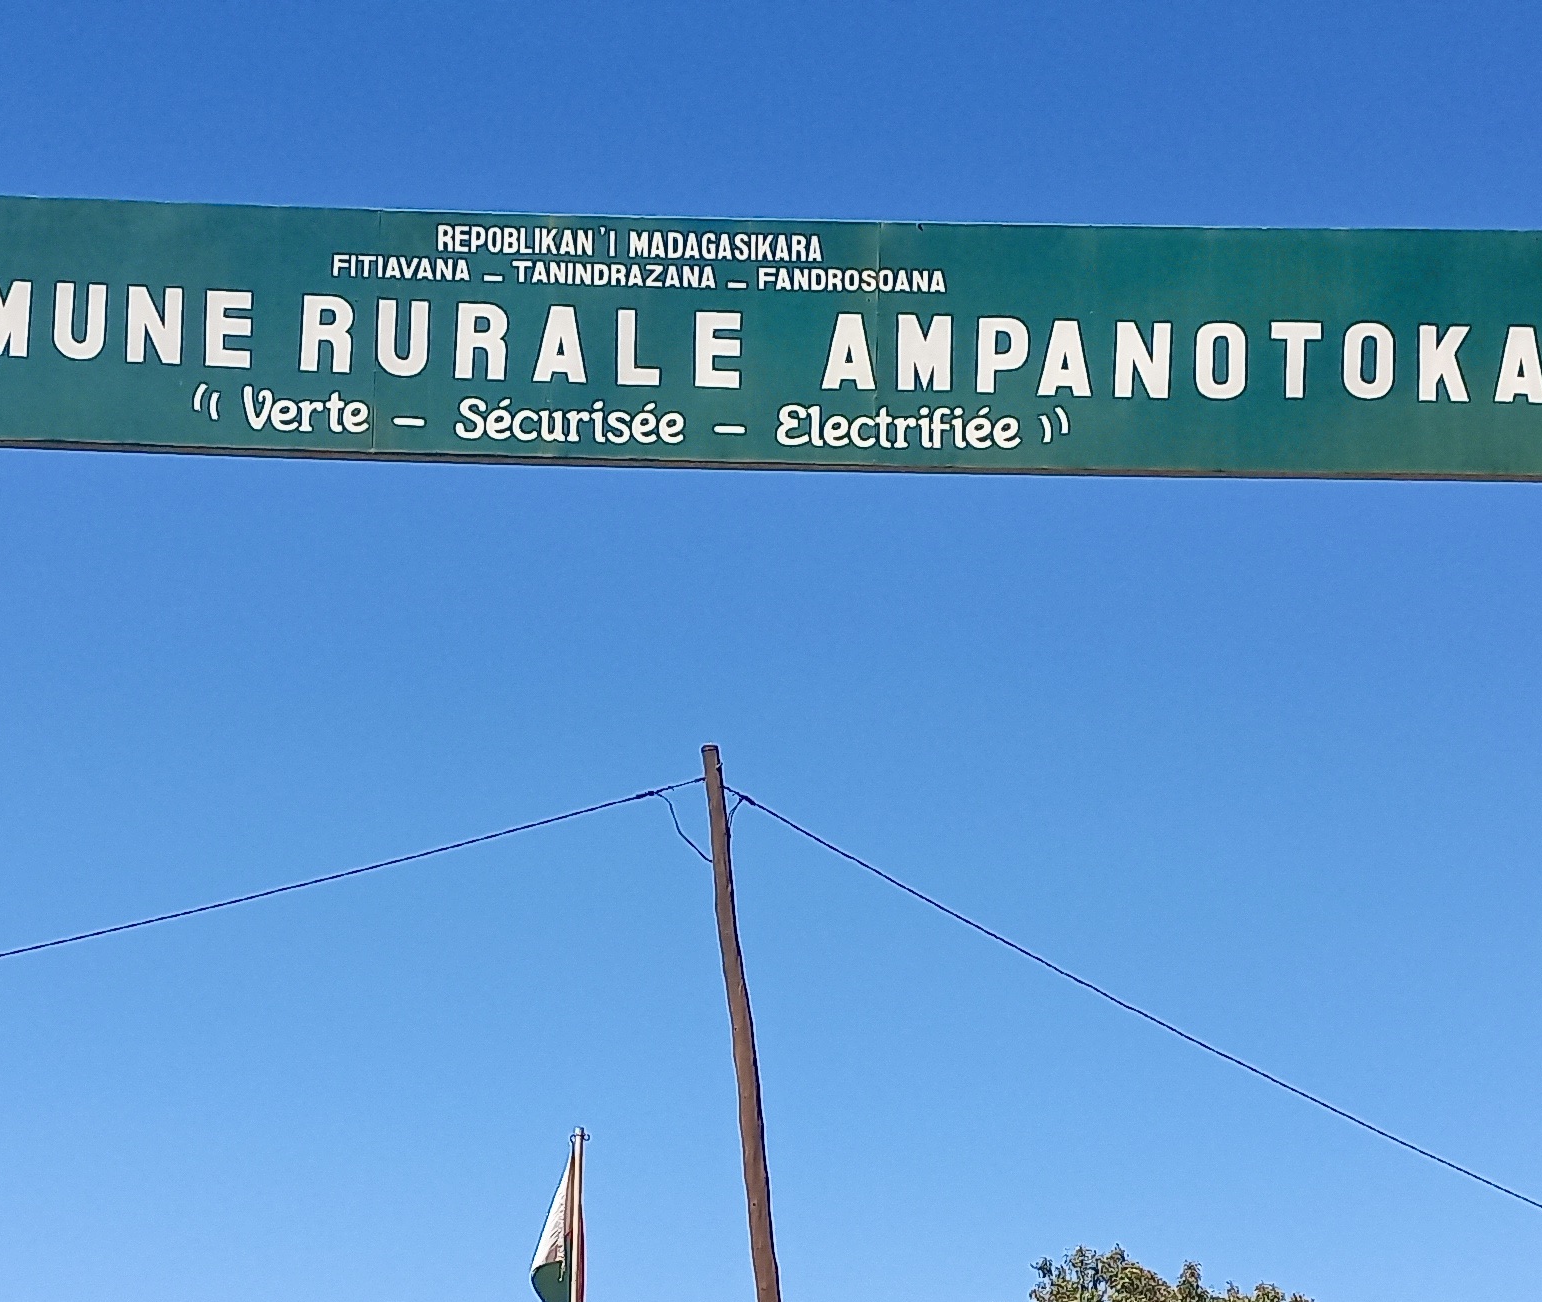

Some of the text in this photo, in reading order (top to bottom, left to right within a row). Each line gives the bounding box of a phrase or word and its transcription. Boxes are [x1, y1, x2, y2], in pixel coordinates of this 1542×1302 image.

[627, 229, 824, 263] MADAGASIKARA
[331, 253, 471, 282] FITIAVANA
[511, 259, 717, 290] TANINDRAZANA
[757, 266, 947, 294] FANDROSOANA
[298, 293, 743, 390] RURALE
[242, 384, 371, 434] Verte
[454, 396, 686, 446] Sécurisée
[775, 403, 1023, 450] Electrifiée
